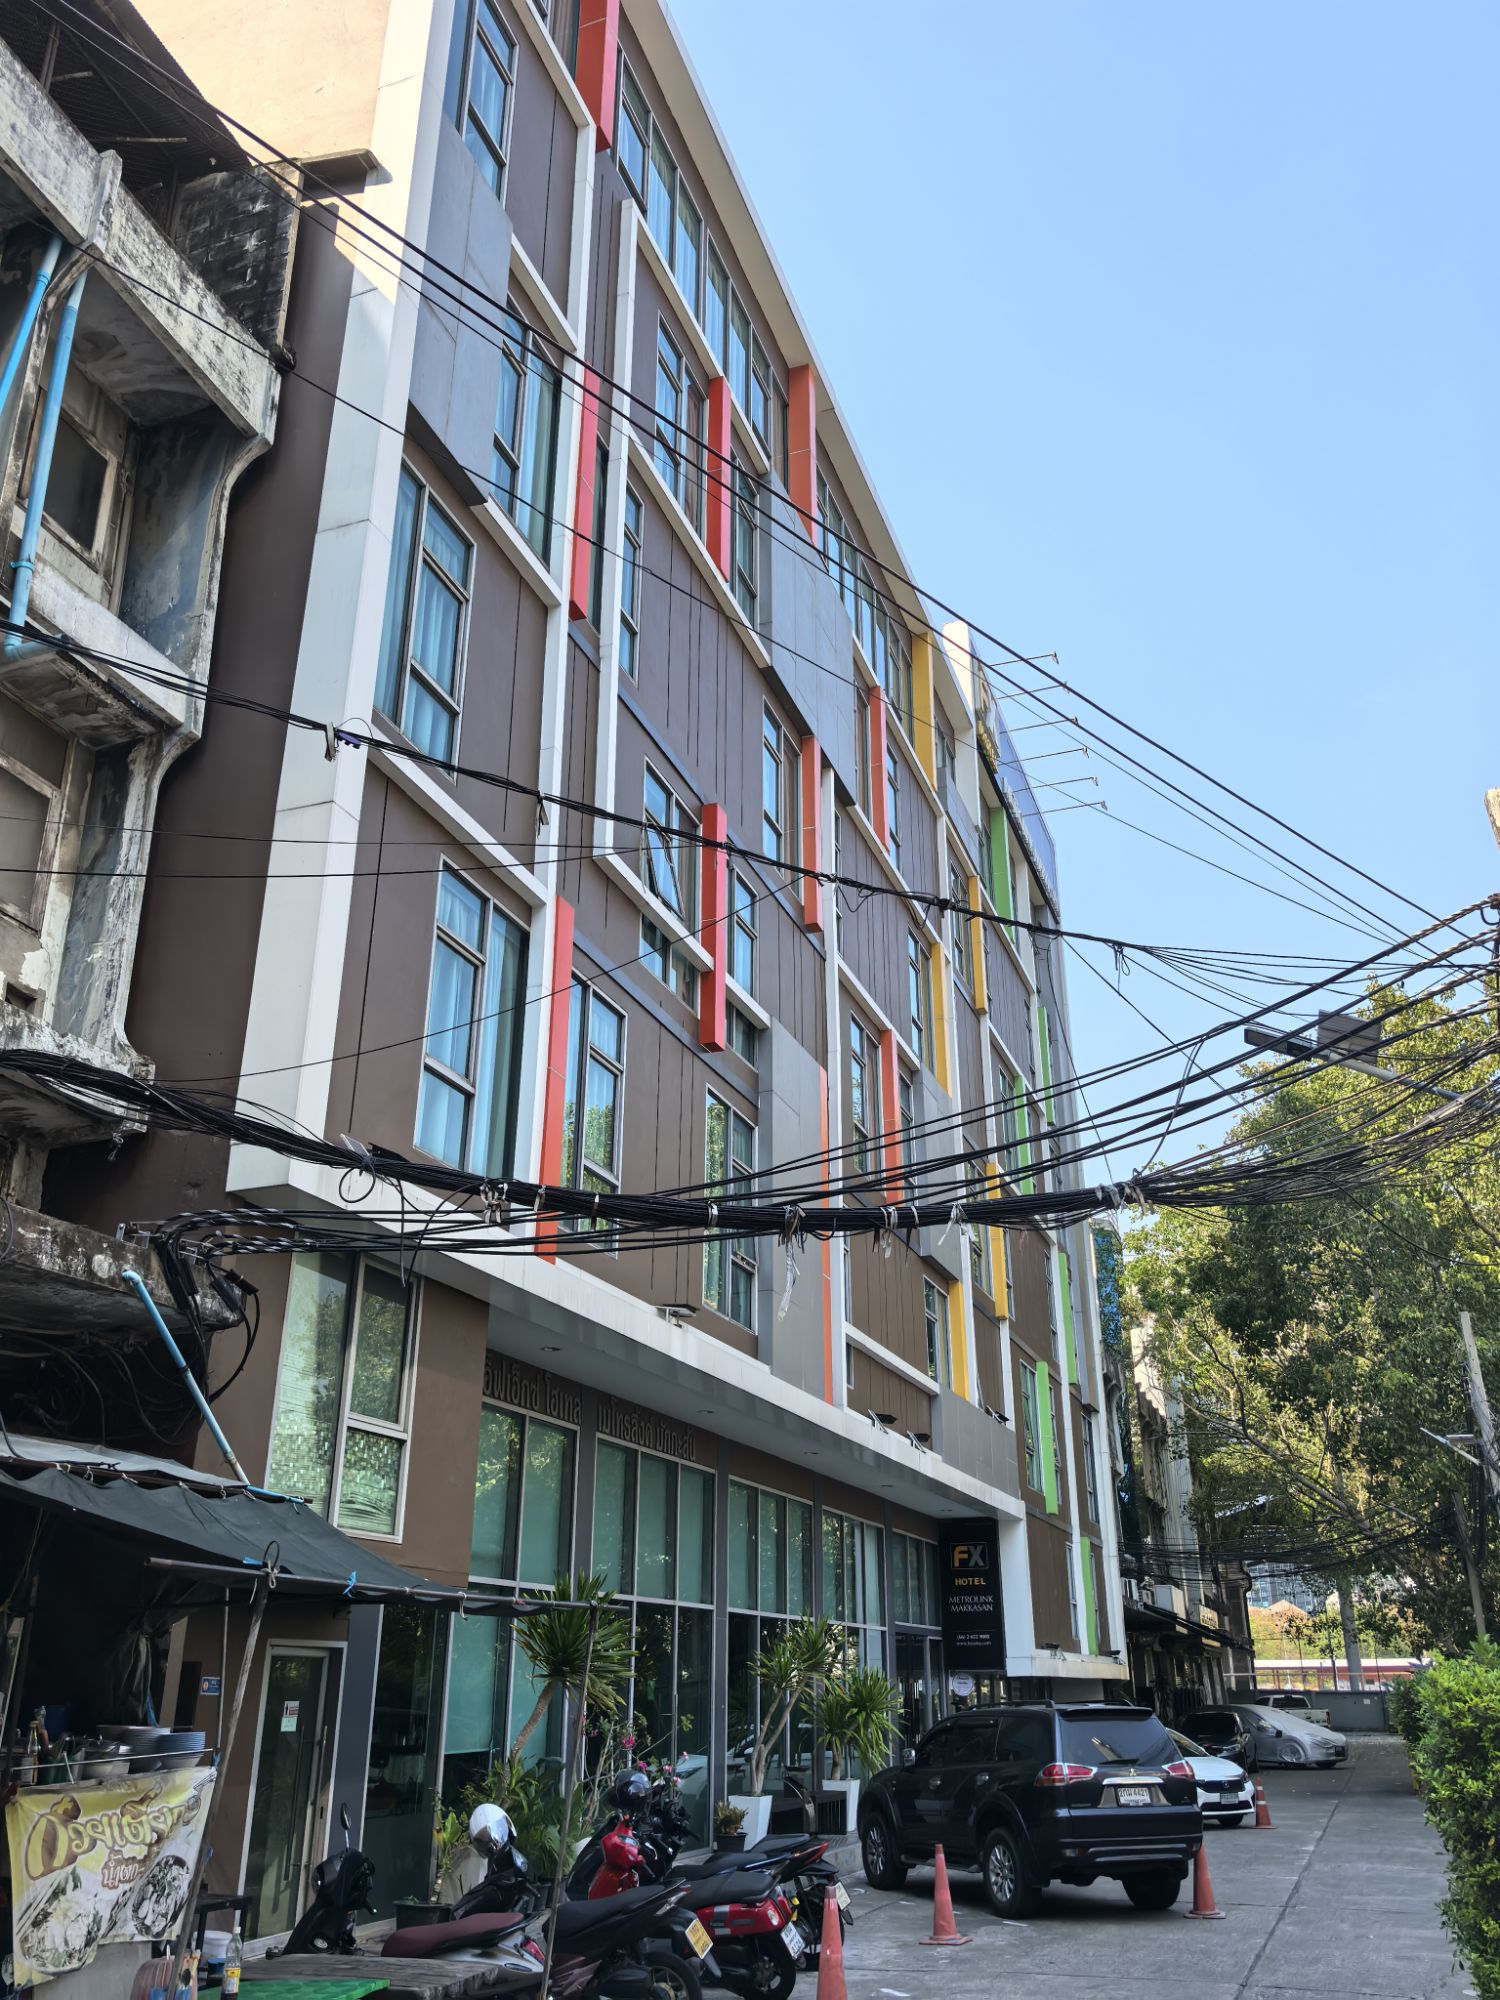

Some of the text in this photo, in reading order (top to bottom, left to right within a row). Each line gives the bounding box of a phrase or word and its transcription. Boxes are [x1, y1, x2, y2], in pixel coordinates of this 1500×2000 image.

[953, 1545, 985, 1568] FX
[954, 1577, 987, 1586] HOTEL
[949, 1595, 994, 1604] METROLINK
[951, 1603, 993, 1612] MAKKASAN
